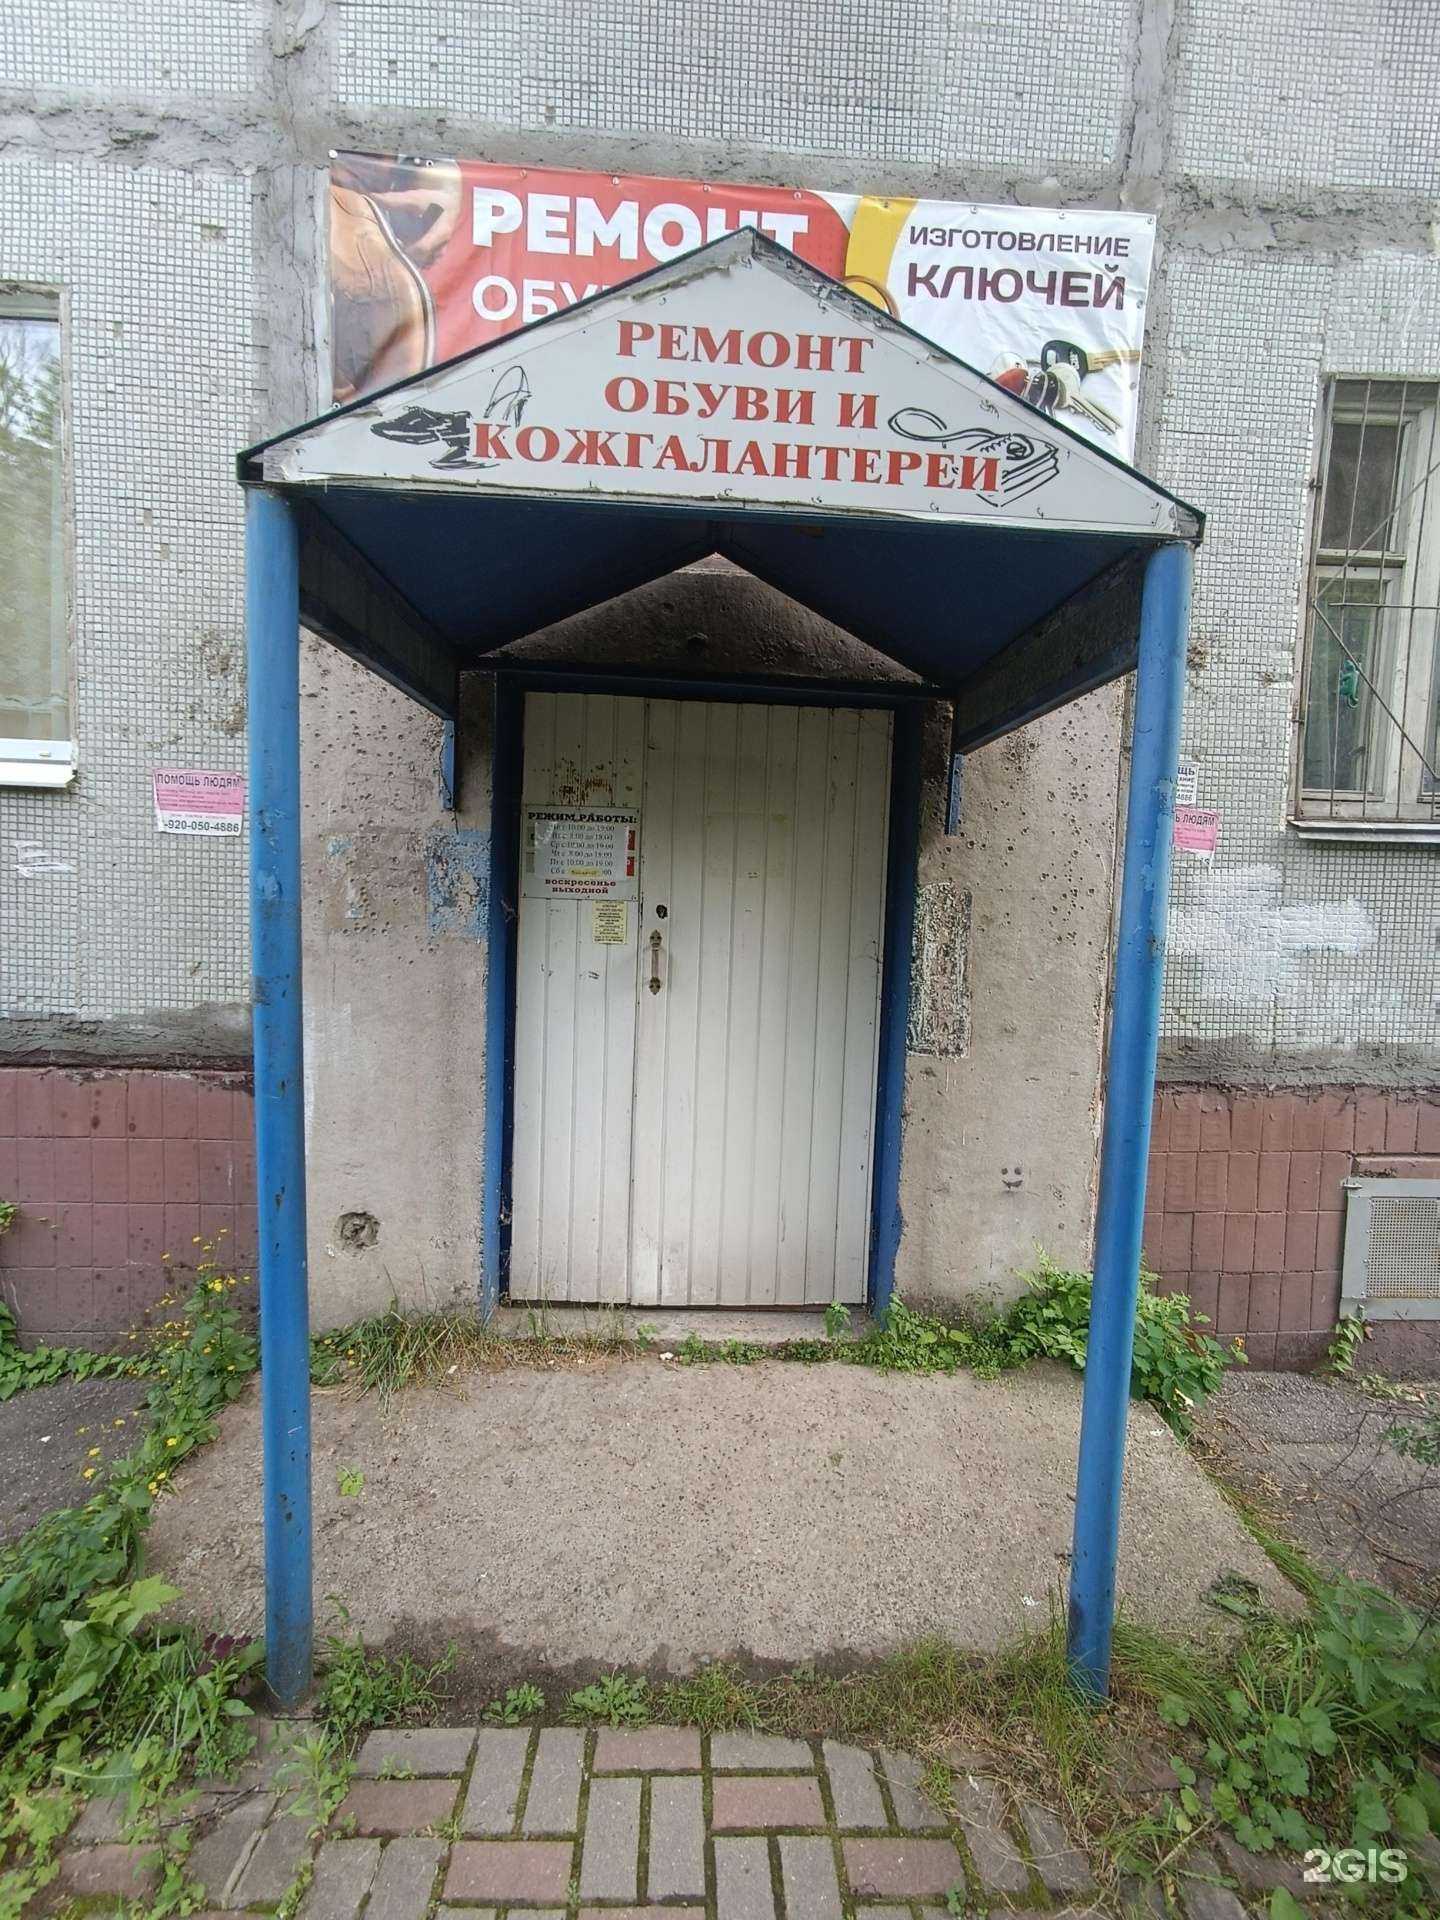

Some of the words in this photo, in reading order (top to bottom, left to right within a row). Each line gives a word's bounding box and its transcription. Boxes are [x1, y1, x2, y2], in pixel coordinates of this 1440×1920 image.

[909, 226, 1131, 257] ИЗГОТОВЛЕНИЕ
[907, 262, 1126, 311] КЛЮЧЕЙ
[616, 319, 874, 374] РЕМОНТ
[604, 376, 816, 426] ОБУВИ
[837, 392, 880, 430] И
[156, 773, 200, 786] ПОМОЩЬ
[203, 777, 240, 788] ЛЮДЯМ
[528, 812, 575, 822] РЕЖИМ
[577, 813, 637, 824] РАБОТЫ:
[1182, 814, 1215, 826] ЛЮДЯМ
